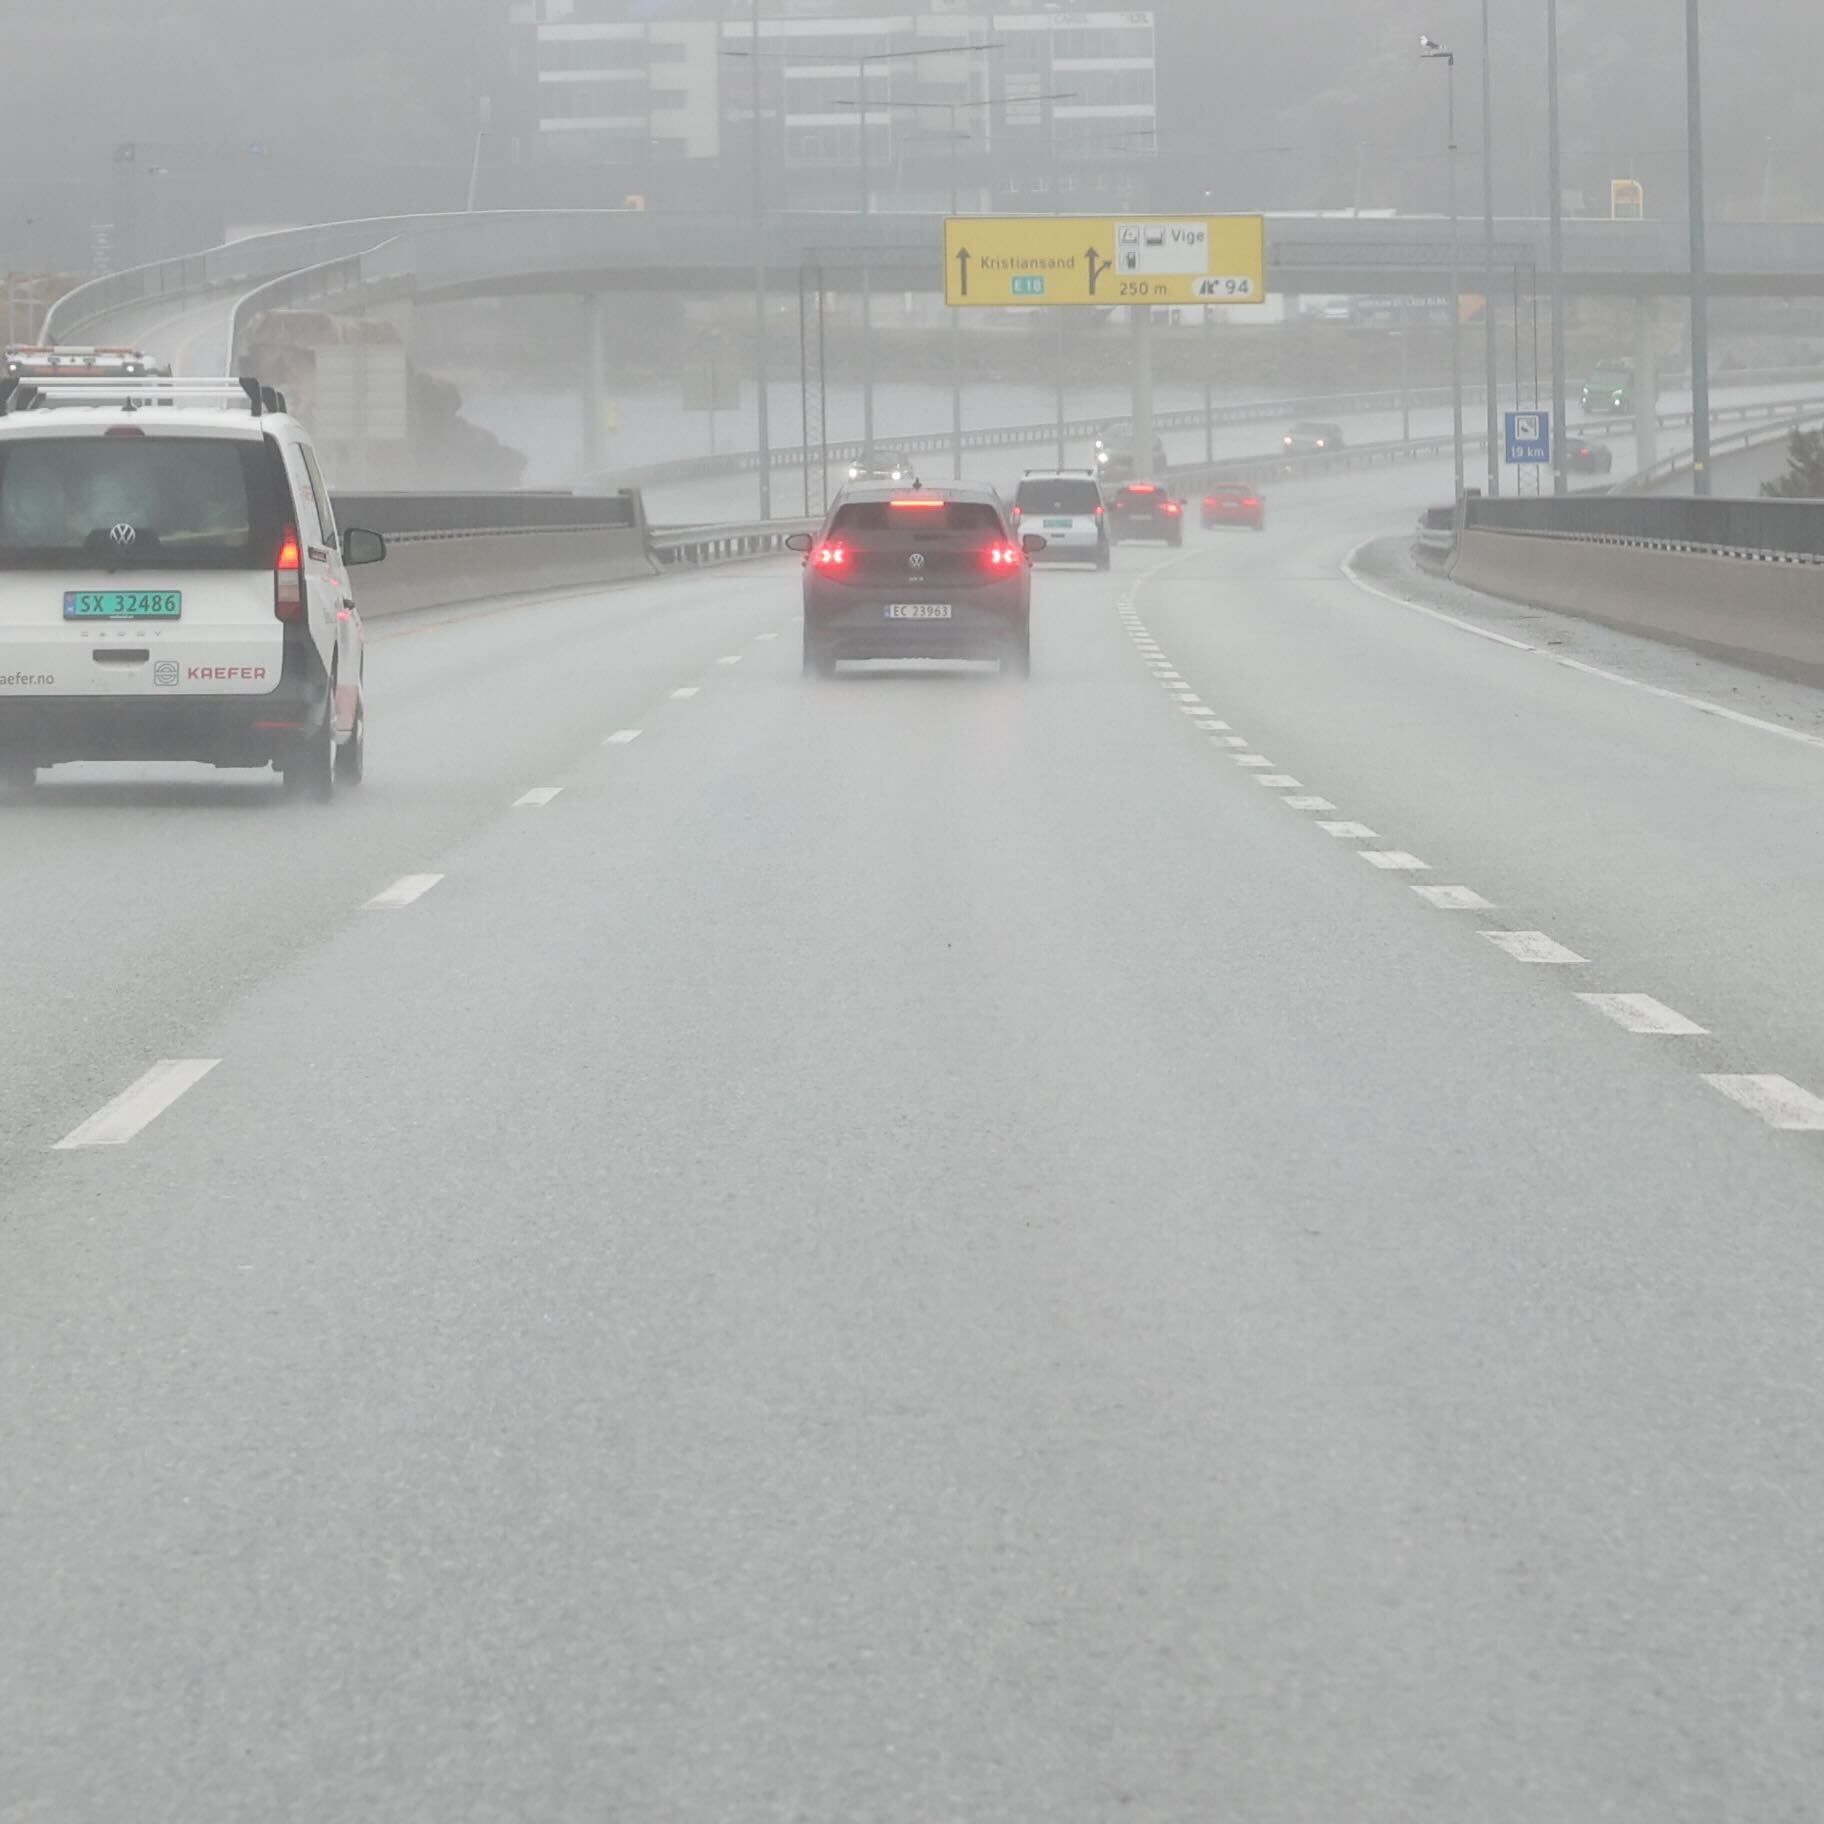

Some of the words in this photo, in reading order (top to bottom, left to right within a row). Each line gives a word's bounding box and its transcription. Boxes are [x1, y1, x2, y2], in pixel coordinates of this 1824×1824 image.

[1171, 229, 1205, 245] Vige
[981, 255, 1075, 271] Kristiansand
[1119, 282, 1148, 295] 250
[1154, 285, 1168, 295] m
[1225, 280, 1249, 294] 94
[1527, 445, 1545, 457] km
[80, 594, 104, 612] SX
[114, 594, 176, 612] 32486
[187, 665, 266, 680] KAEFER
